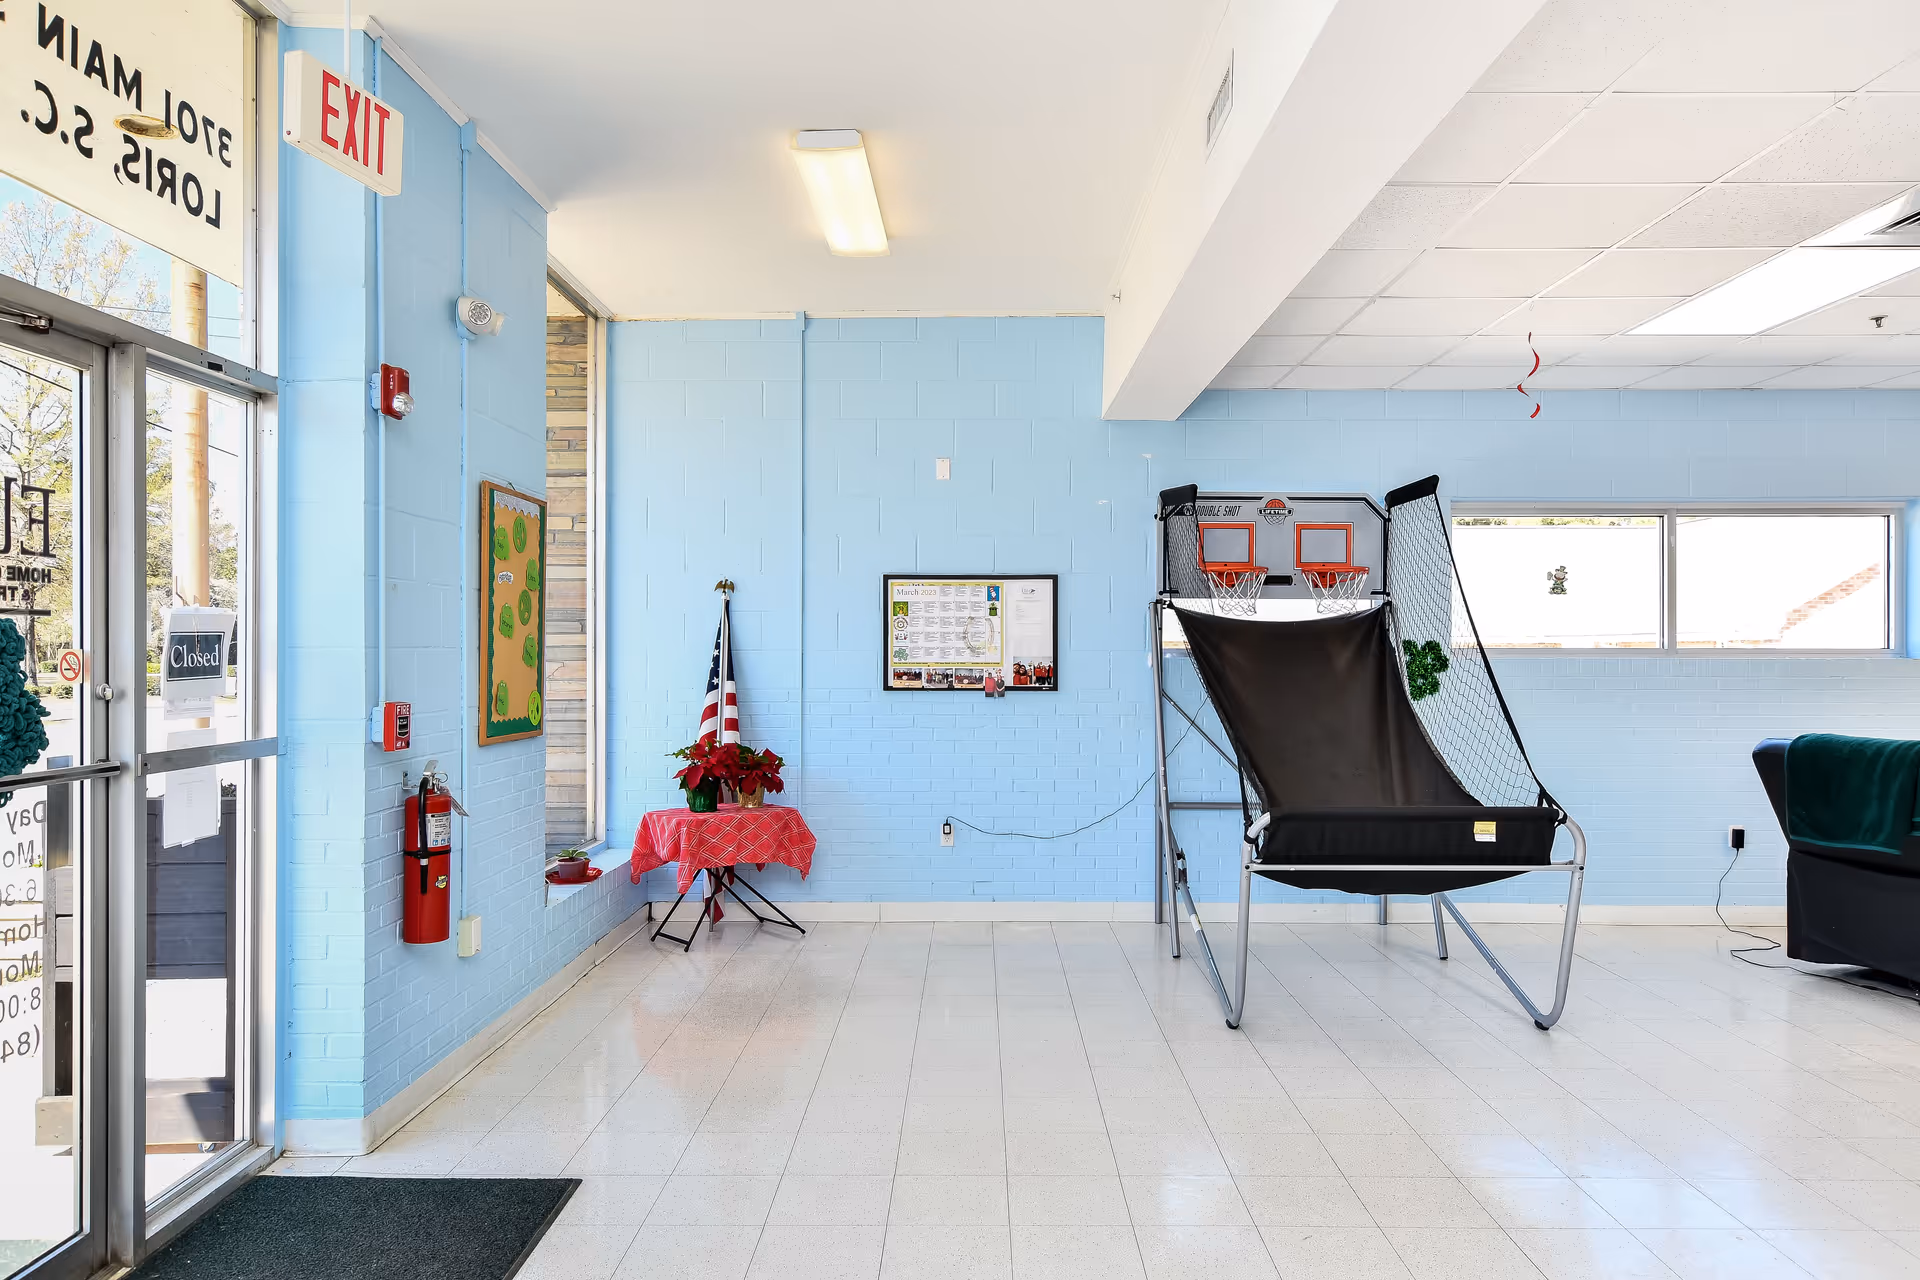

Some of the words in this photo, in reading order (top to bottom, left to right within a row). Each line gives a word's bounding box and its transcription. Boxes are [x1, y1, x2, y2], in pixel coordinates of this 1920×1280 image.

[321, 69, 391, 176] EXIT
[1196, 505, 1223, 517] DOUBLE
[1223, 505, 1243, 517] SHOT
[896, 588, 919, 596] March
[170, 644, 220, 669] Closed
[396, 704, 410, 716] FIRE
